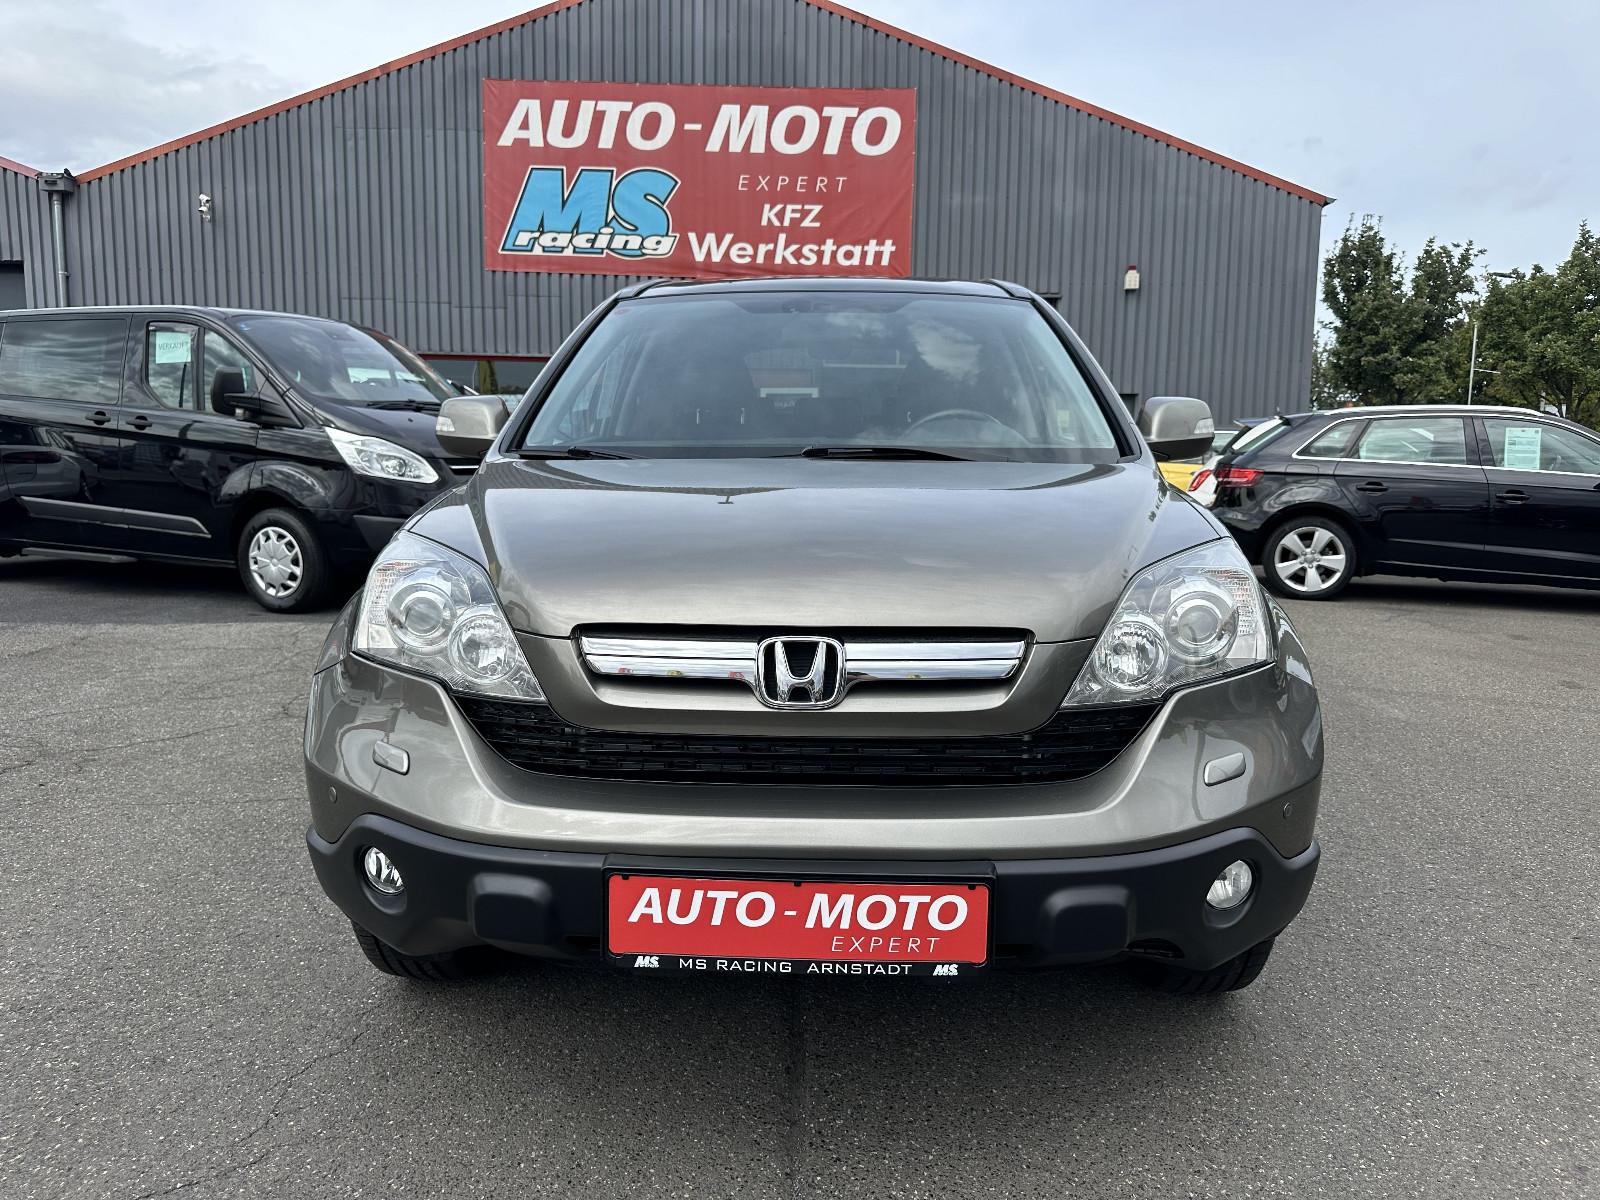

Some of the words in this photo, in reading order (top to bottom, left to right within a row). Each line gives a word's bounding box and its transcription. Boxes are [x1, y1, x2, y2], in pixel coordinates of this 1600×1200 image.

[498, 99, 676, 150] AUTO
[705, 104, 901, 157] MOTO
[738, 175, 848, 193] EXPERT
[500, 166, 680, 258] MS
[760, 203, 824, 228] KFZ
[513, 227, 679, 255] racing
[687, 232, 896, 267] Werkstatt
[627, 887, 776, 928] AUTO
[804, 893, 969, 931] MOTO
[831, 936, 941, 953] EXPERT
[679, 958, 707, 970] MS
[716, 959, 792, 973] RACING
[806, 962, 913, 975] ARNSTADT
